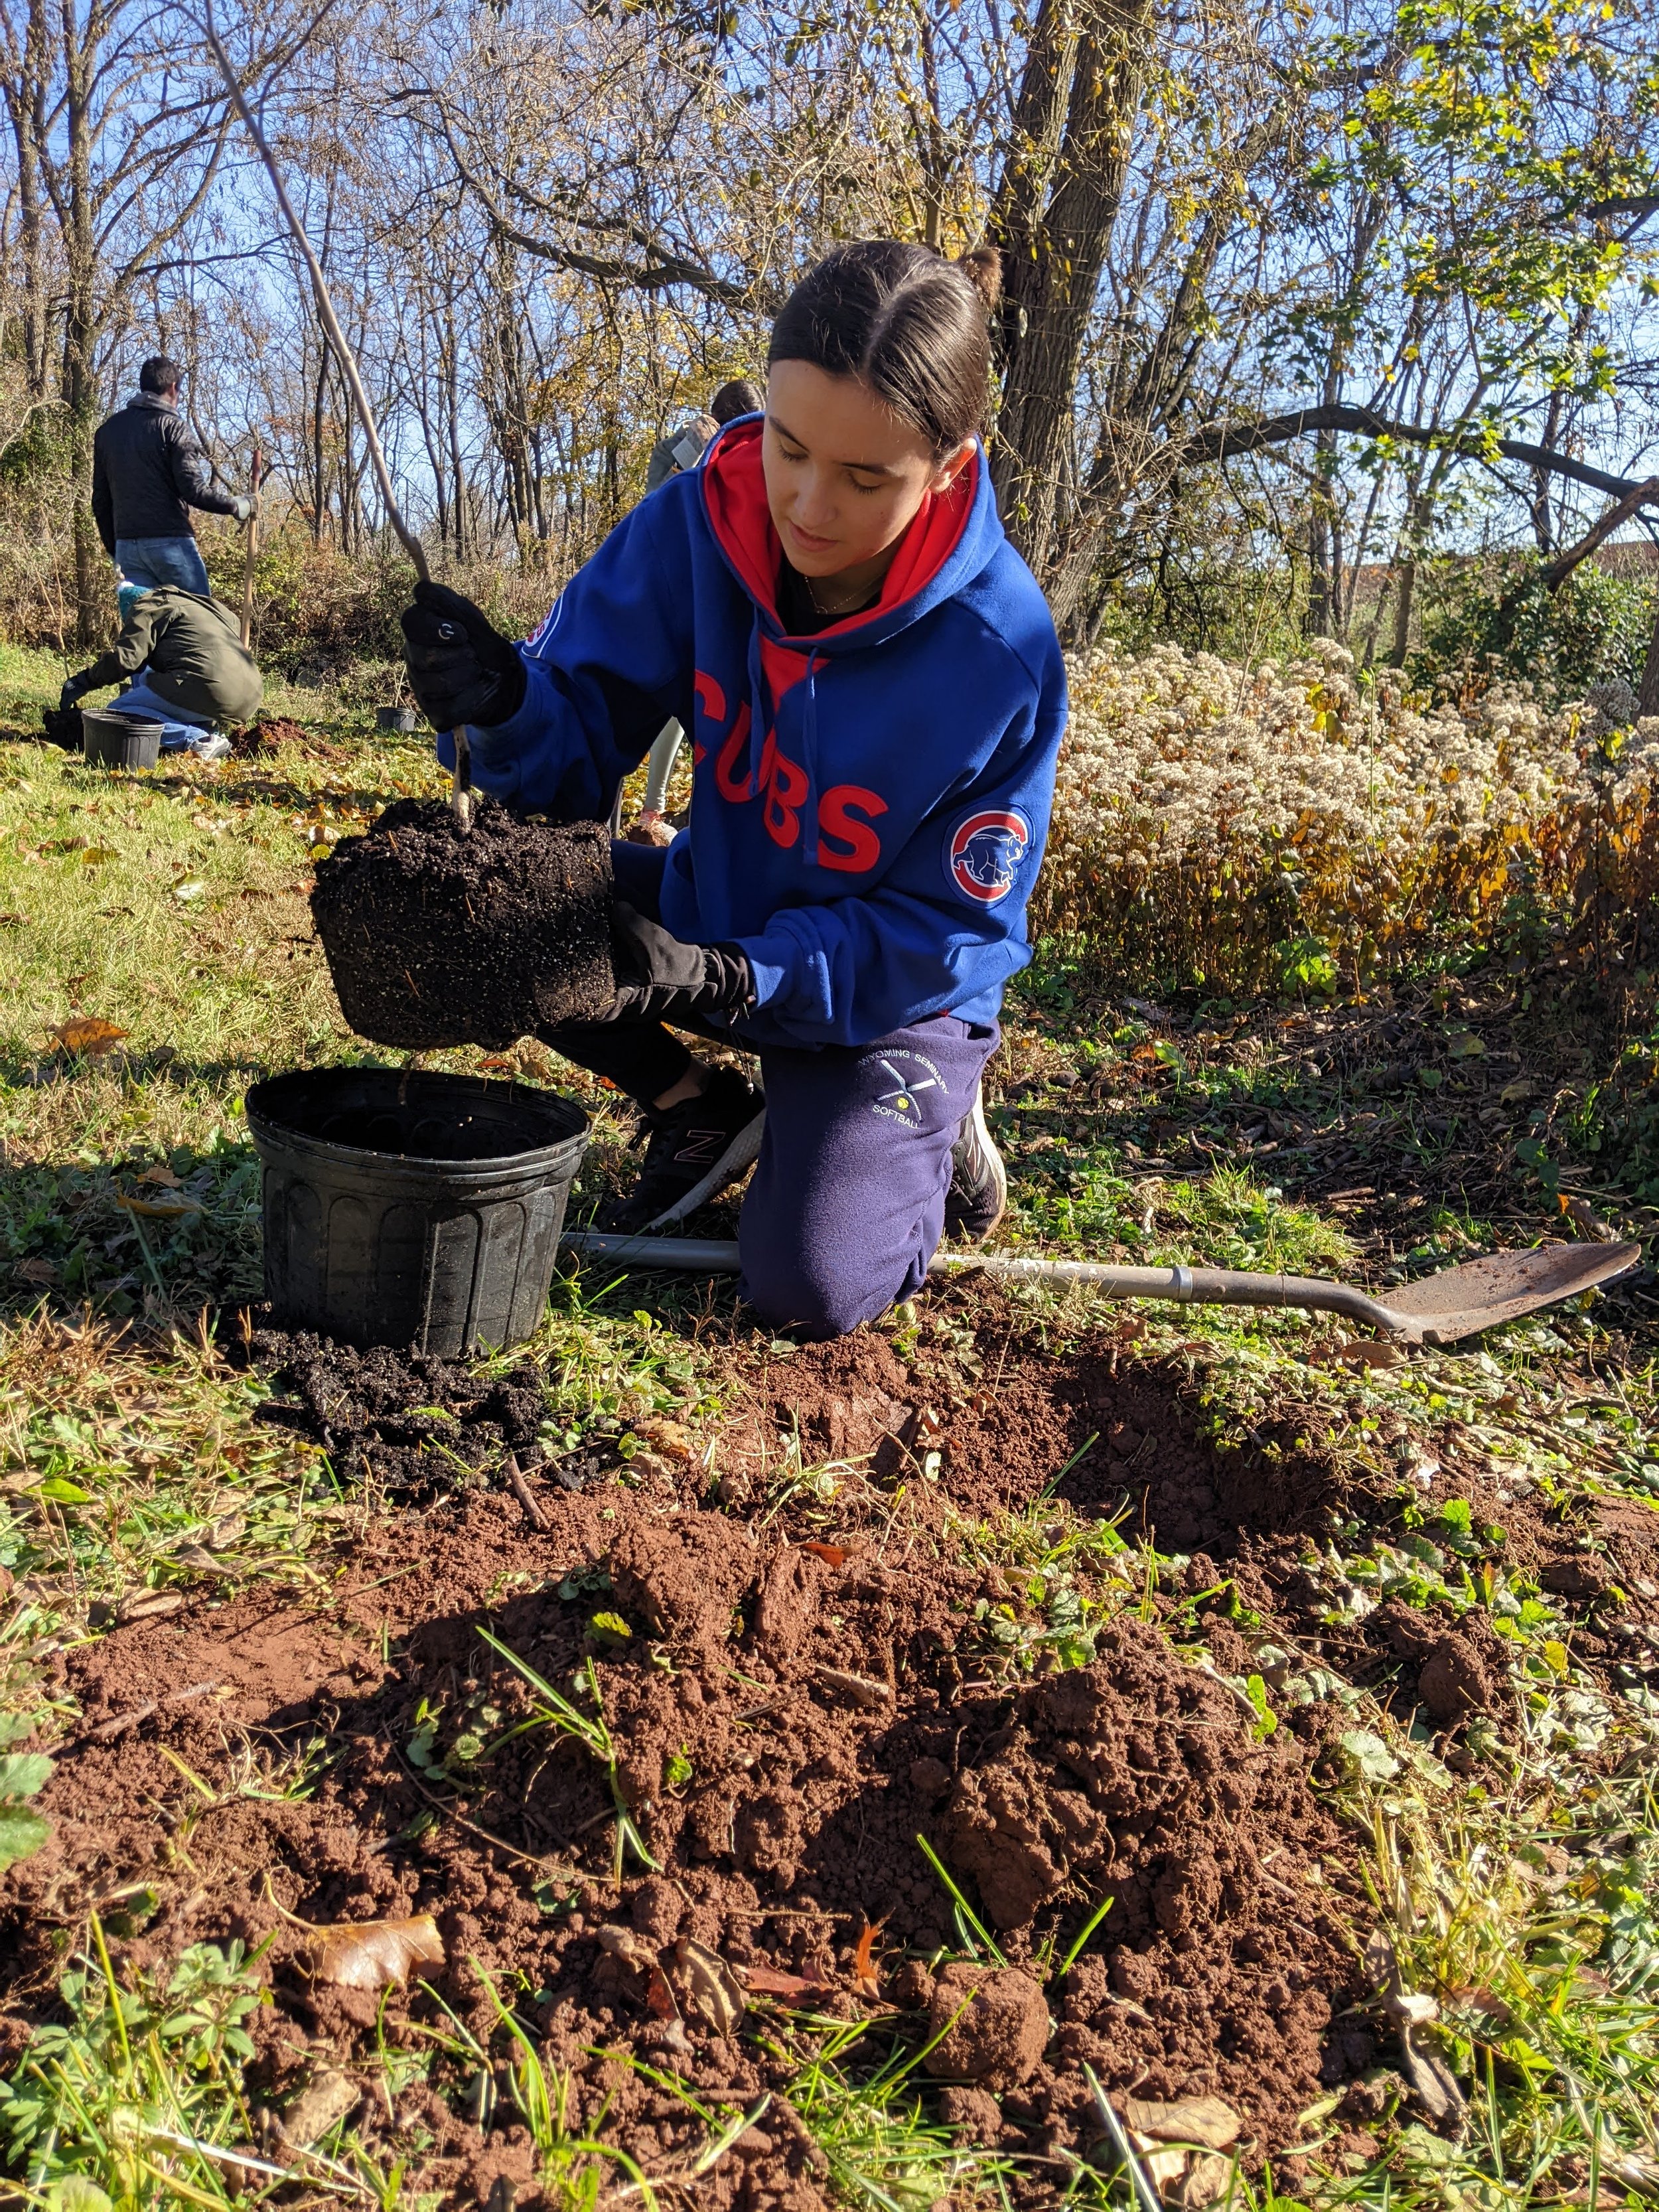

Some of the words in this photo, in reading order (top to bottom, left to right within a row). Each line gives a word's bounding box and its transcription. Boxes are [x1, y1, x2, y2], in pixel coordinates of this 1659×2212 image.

[858, 1049, 910, 1066] WYOMING
[914, 1054, 950, 1094] SEMINARY
[873, 1104, 921, 1129] SOFTBALL
